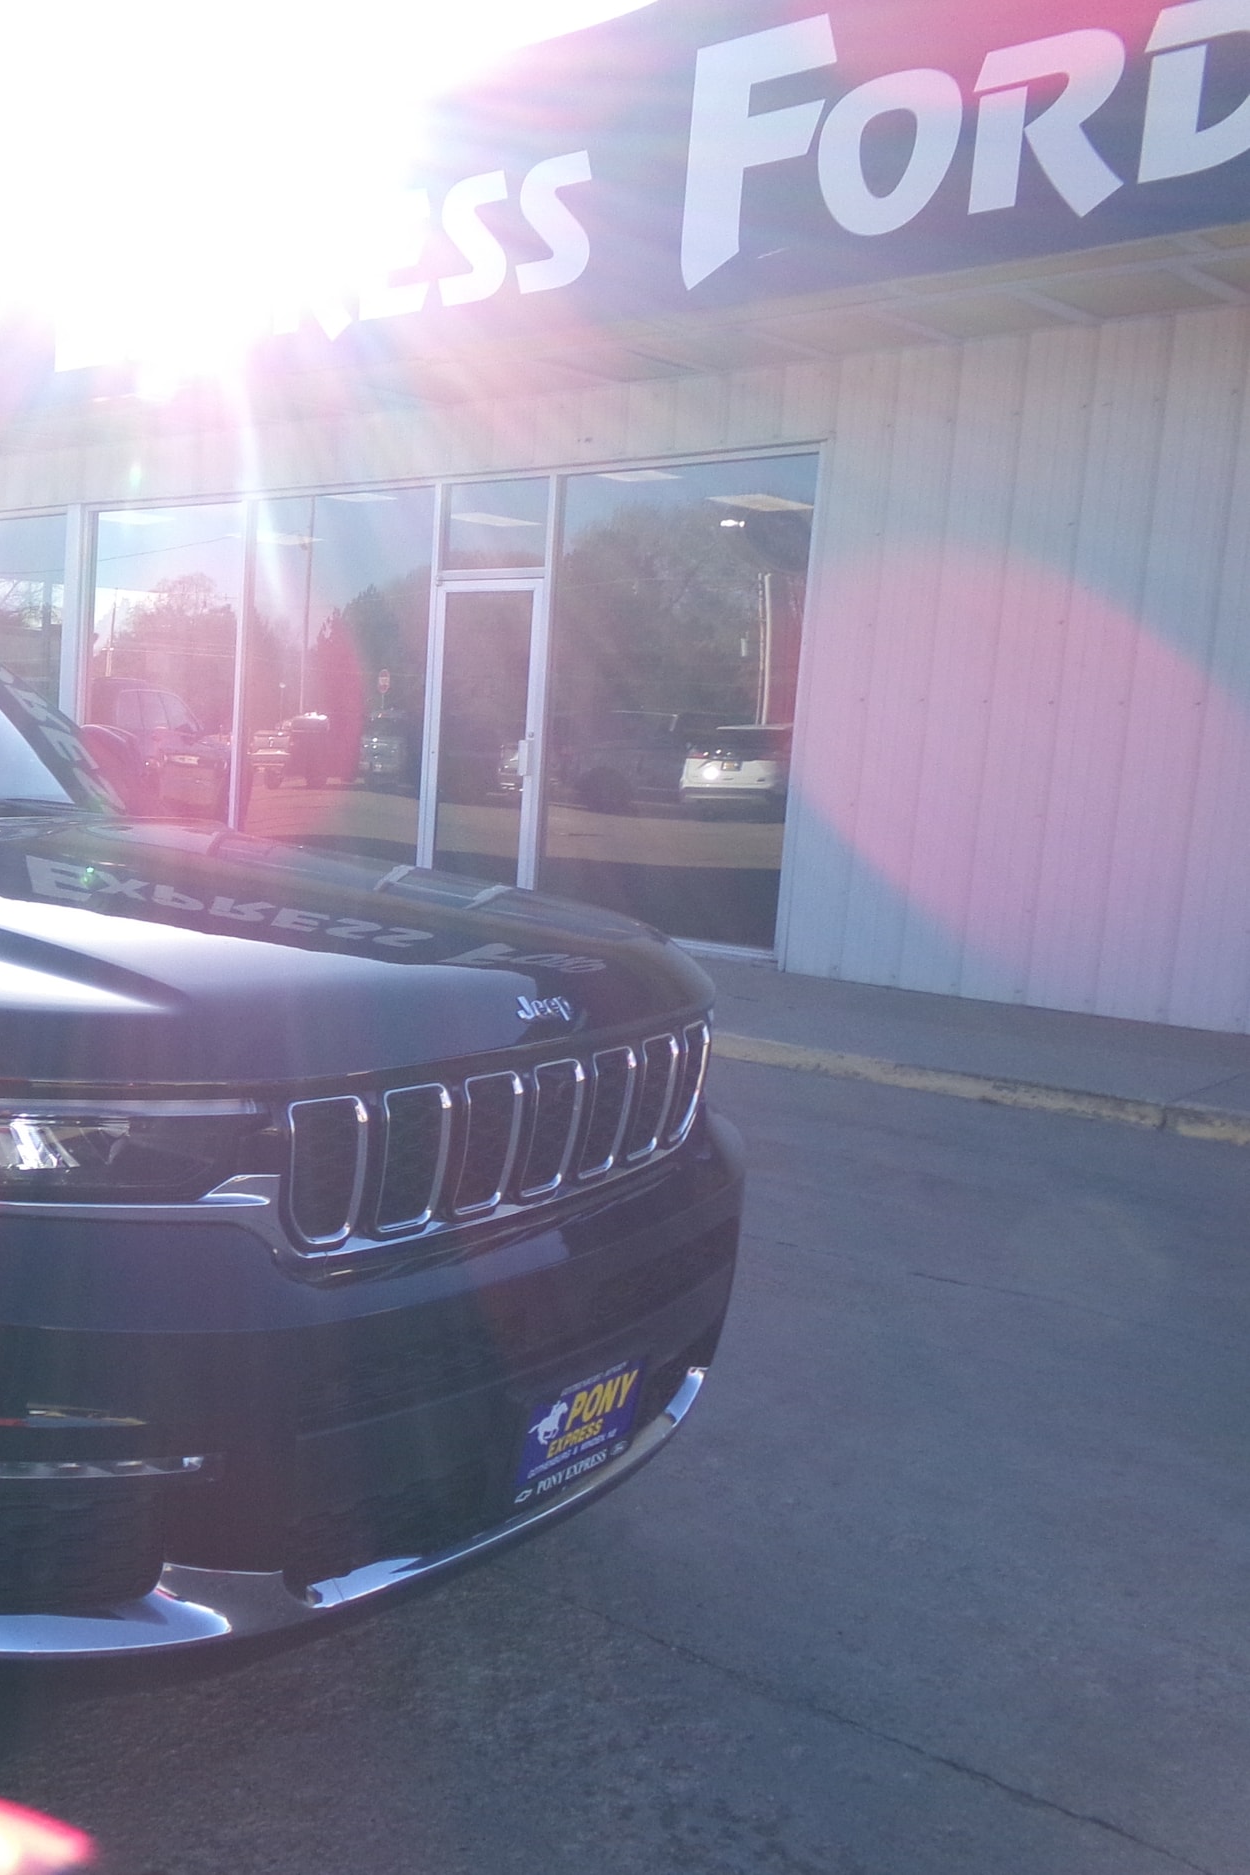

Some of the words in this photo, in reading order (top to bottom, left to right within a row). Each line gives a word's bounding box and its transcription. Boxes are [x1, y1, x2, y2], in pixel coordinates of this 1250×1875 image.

[515, 995, 572, 1021] Jeep
[564, 1368, 639, 1432] PONY
[546, 1418, 604, 1459] EXPRESS
[536, 1468, 566, 1495] PONY
[565, 1447, 608, 1480] EXPRESS
